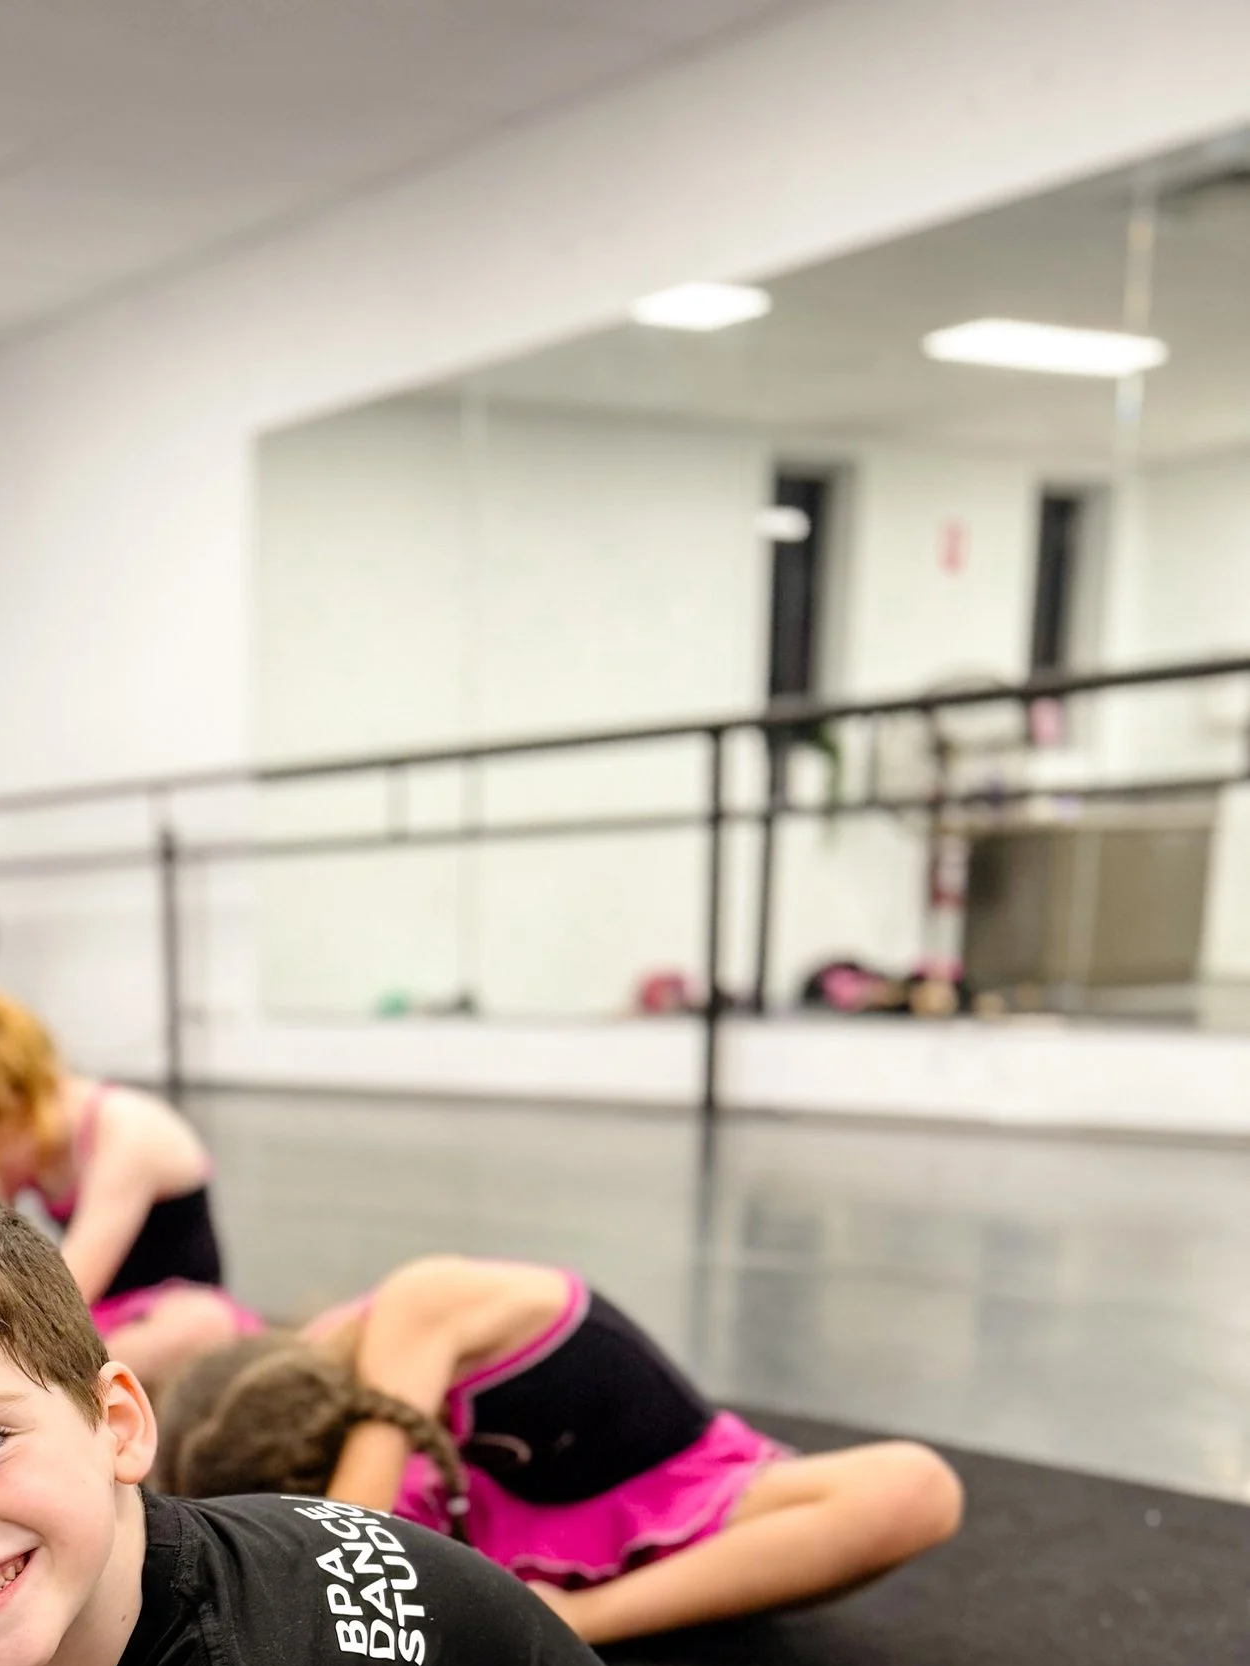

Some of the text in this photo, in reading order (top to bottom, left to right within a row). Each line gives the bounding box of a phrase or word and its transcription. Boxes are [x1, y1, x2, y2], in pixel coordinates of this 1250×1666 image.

[293, 1505, 396, 1660] DANCE
[316, 1547, 368, 1656] BPA
[322, 1501, 426, 1666] STUDIO
